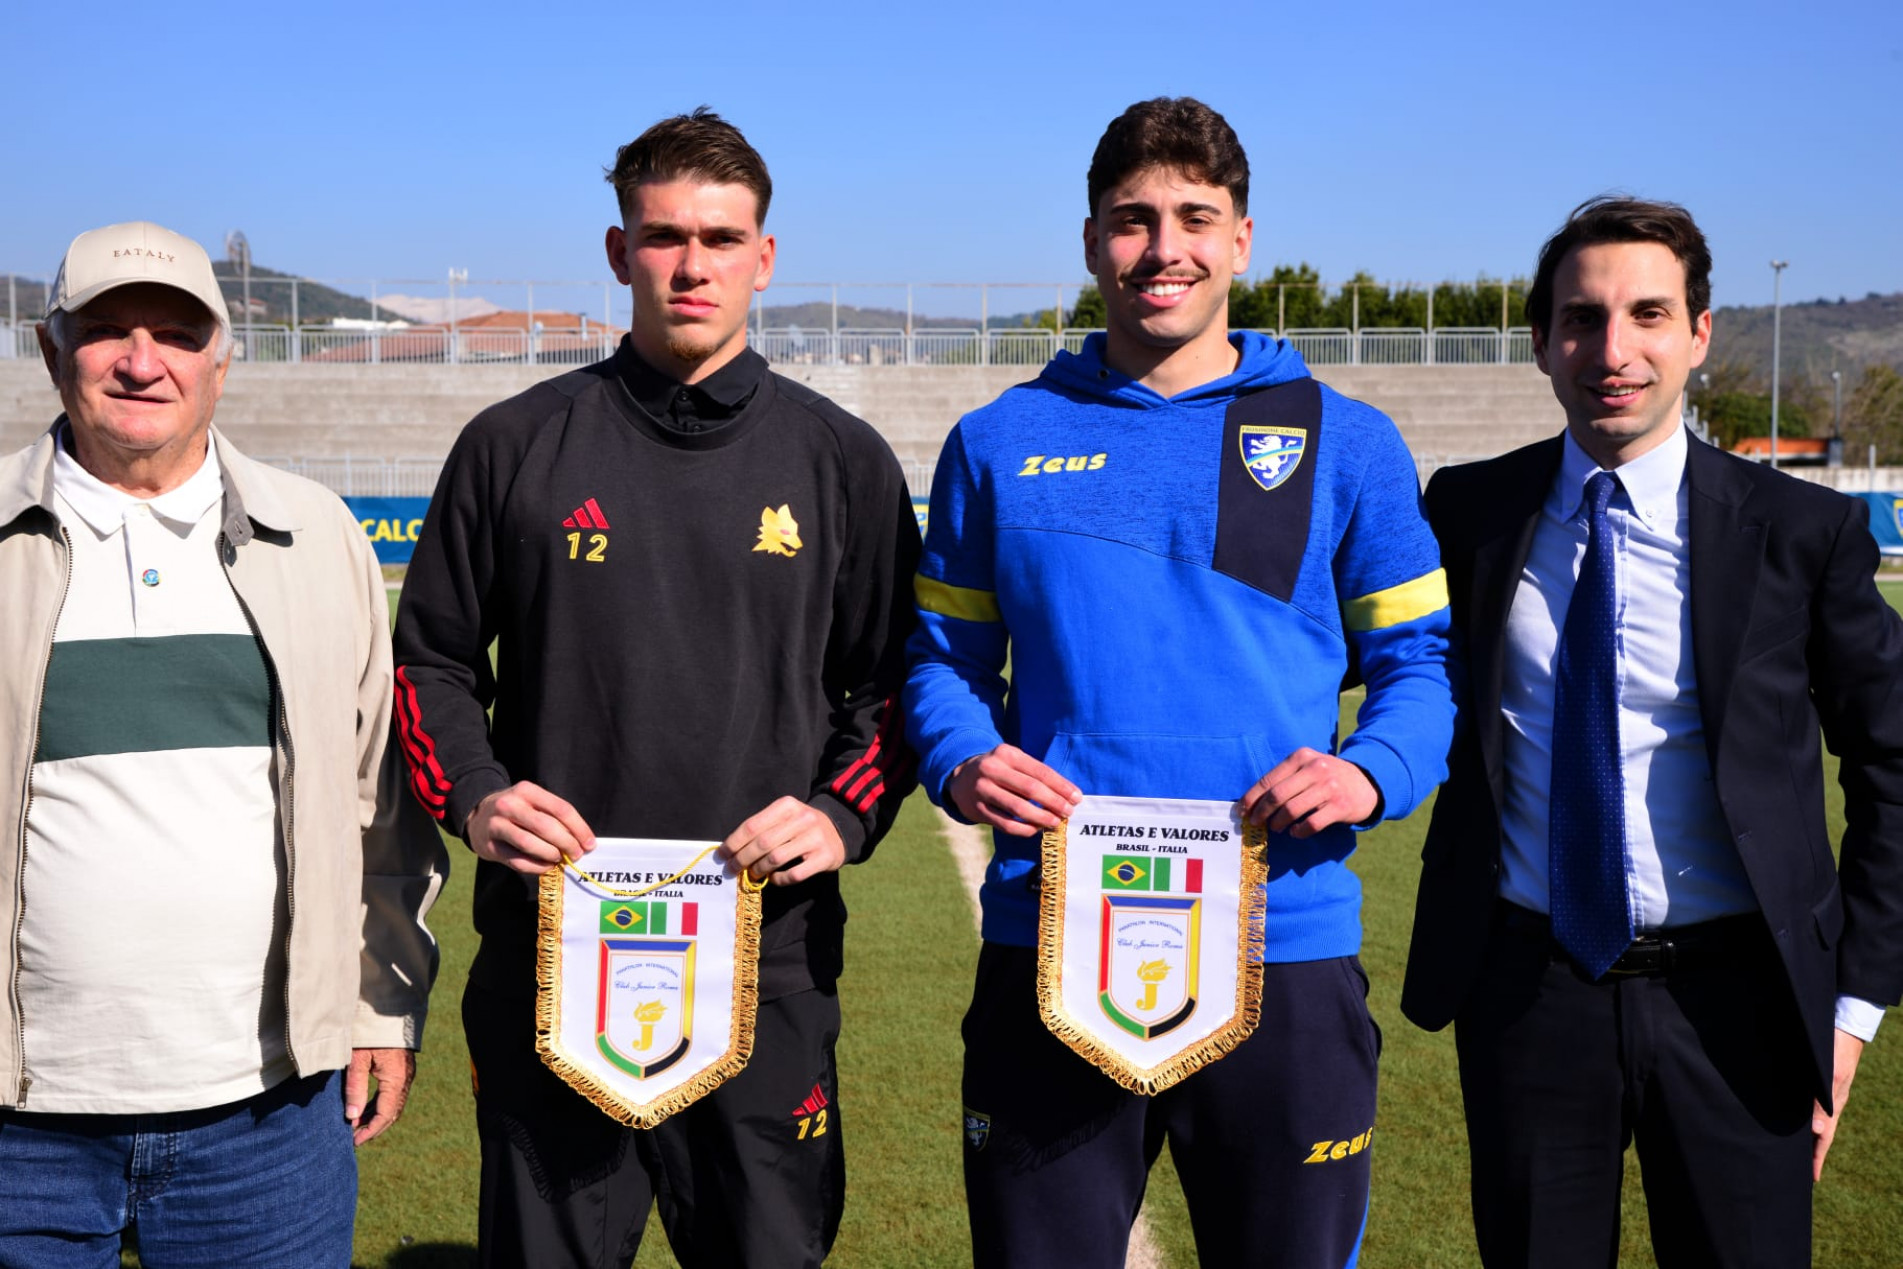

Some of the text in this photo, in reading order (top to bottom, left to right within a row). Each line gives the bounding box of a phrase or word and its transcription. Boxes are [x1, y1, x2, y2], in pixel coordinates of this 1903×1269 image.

[113, 248, 175, 262] EATALY
[1018, 453, 1107, 476] Zeus
[567, 532, 608, 562] 12
[1080, 824, 1229, 842] ATLETAS E VALORES
[1116, 843, 1150, 852] BRASIL
[1158, 845, 1188, 854] ITALIA
[578, 871, 641, 883] ATLETAS
[645, 872, 653, 884] E
[655, 890, 683, 898] ITALIA
[797, 1109, 827, 1140] 12
